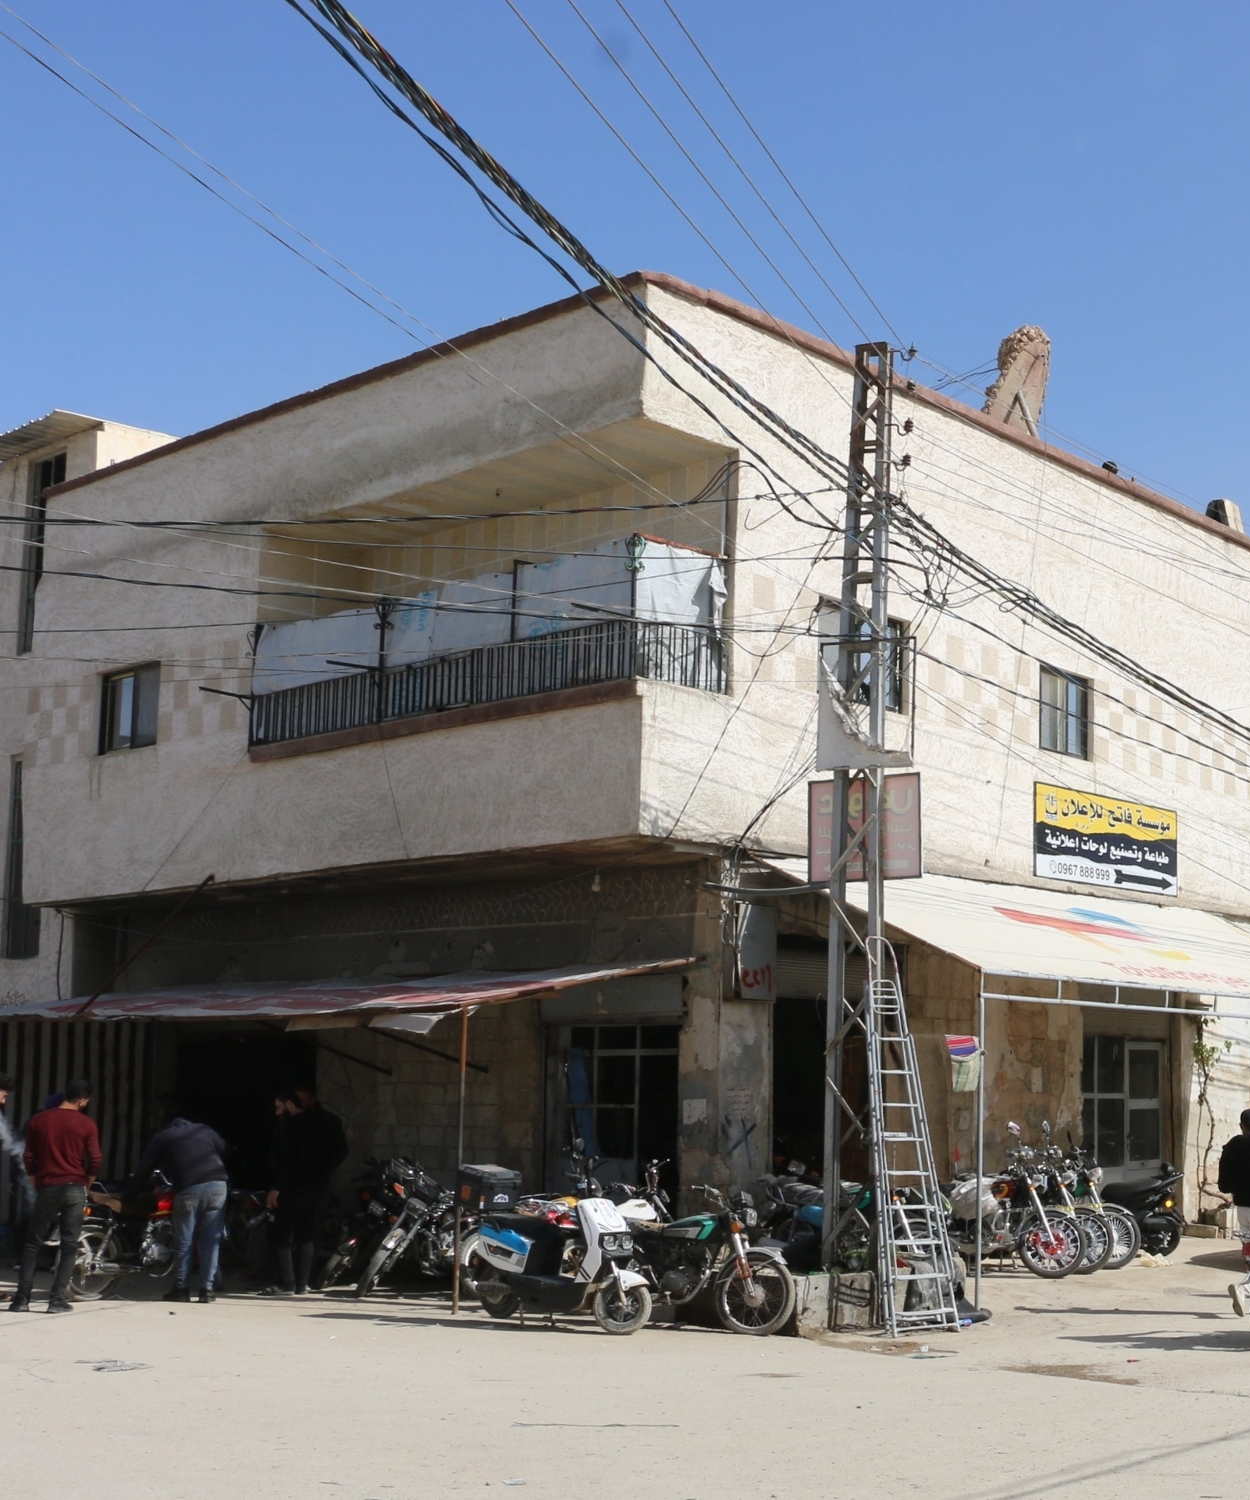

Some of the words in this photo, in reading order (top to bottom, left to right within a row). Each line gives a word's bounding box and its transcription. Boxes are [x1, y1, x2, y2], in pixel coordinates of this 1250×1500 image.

[1062, 798, 1103, 823] للإعلان
[1108, 806, 1133, 827] فاتح
[1137, 809, 1170, 835] مؤسسة
[1045, 829, 1080, 852] إعلانية
[1081, 836, 1108, 856] لوحات
[1110, 843, 1142, 862] وتصنيع
[1143, 847, 1169, 867] طباعة
